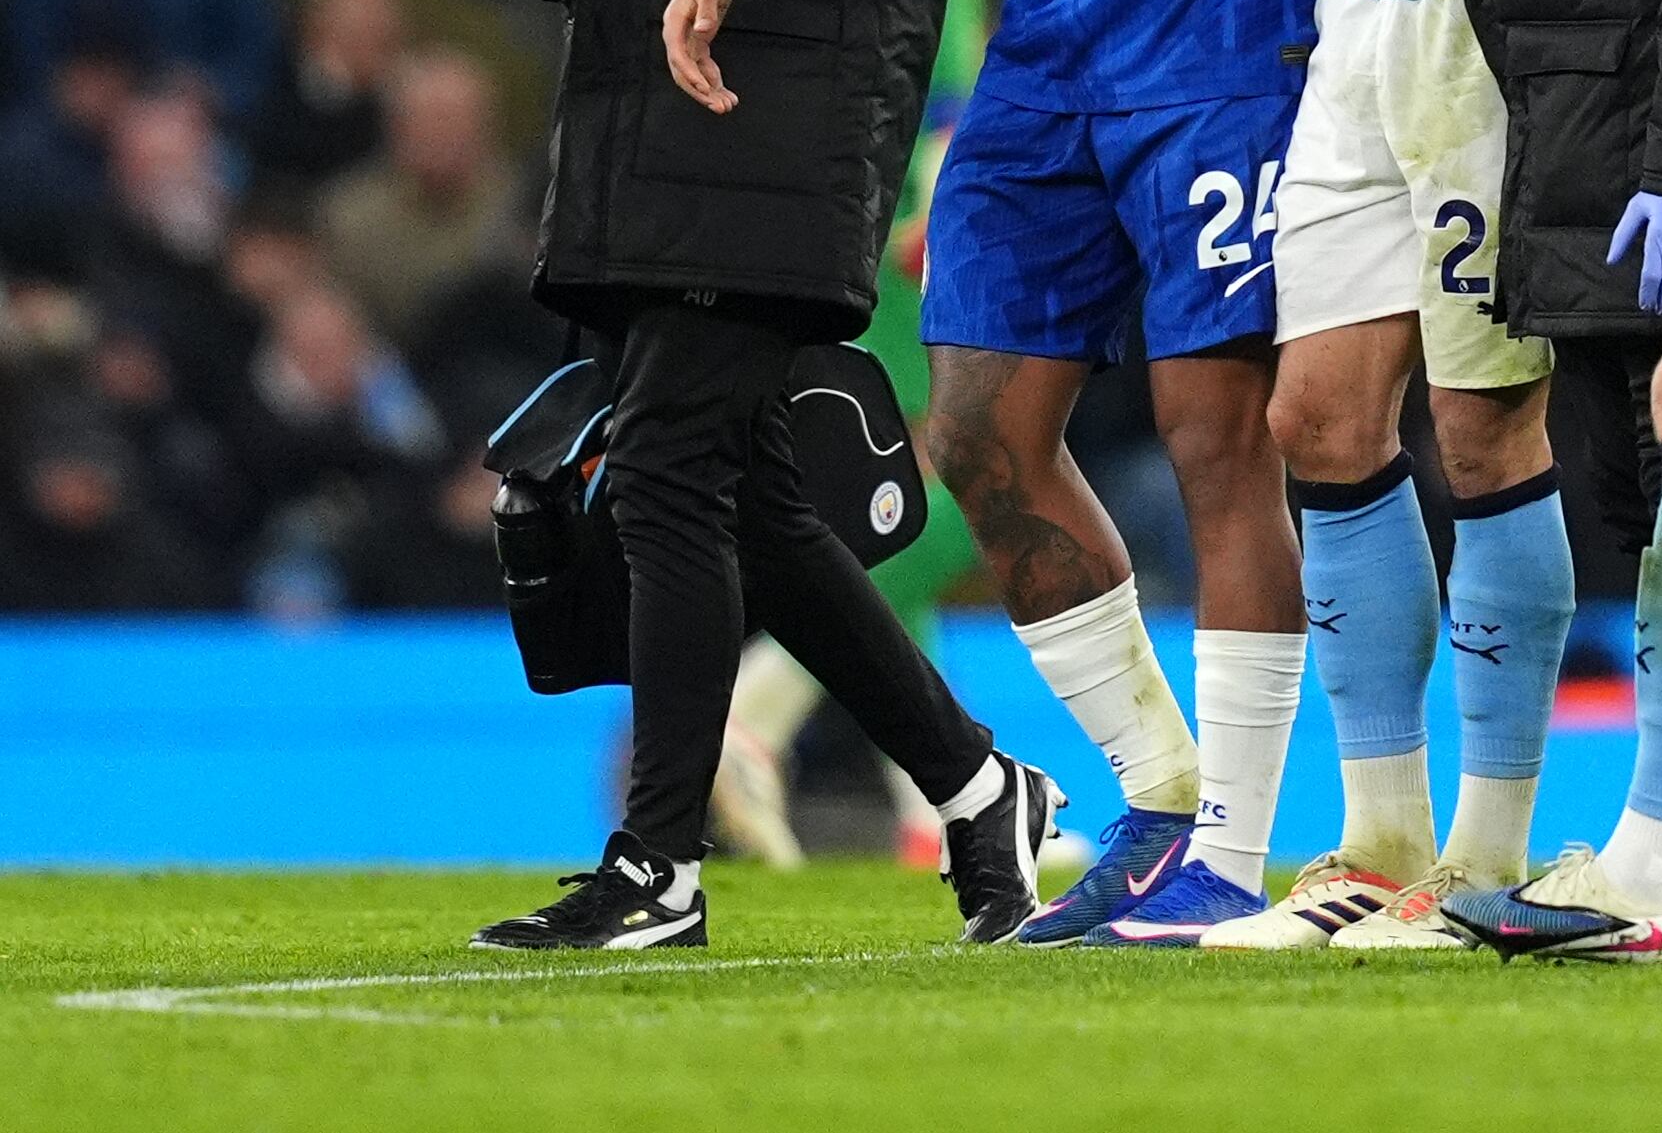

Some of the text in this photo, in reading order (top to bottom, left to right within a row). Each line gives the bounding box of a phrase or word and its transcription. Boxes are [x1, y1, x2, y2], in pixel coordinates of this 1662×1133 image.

[1188, 160, 1278, 270] 24
[1433, 198, 1490, 294] 2
[1306, 598, 1336, 609] TY
[1198, 798, 1227, 819] FC
[614, 855, 649, 887] PUMA
